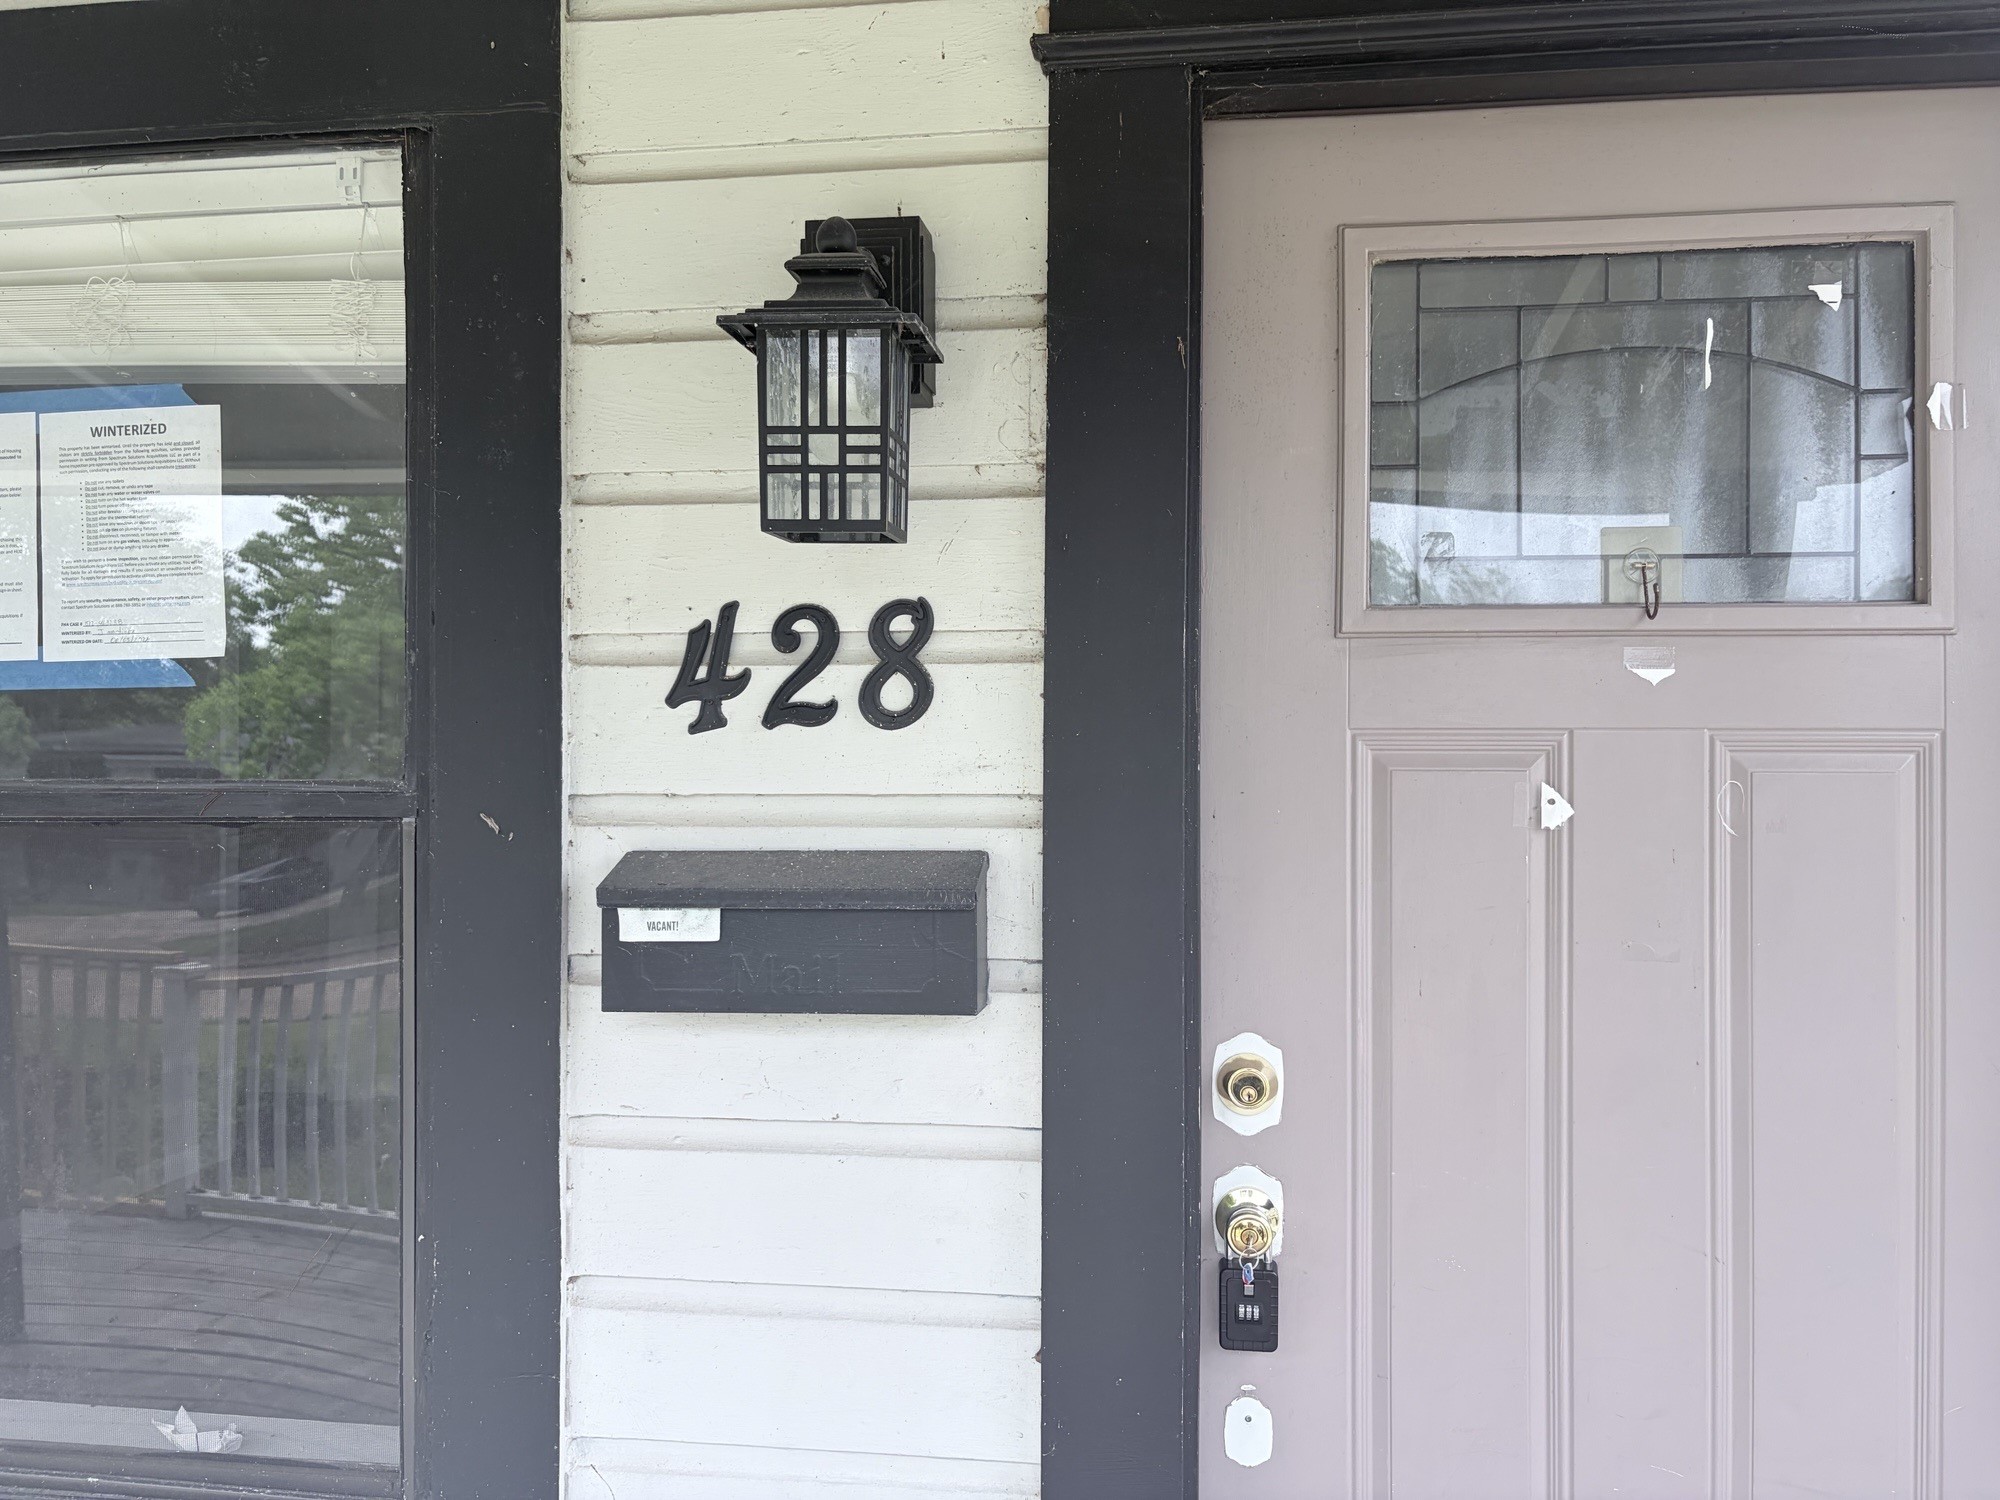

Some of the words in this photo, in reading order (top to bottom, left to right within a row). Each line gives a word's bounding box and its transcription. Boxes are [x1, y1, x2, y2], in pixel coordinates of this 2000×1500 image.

[90, 423, 167, 438] WINTERIZED
[665, 596, 934, 735] 428
[646, 921, 678, 932] VACANT!
